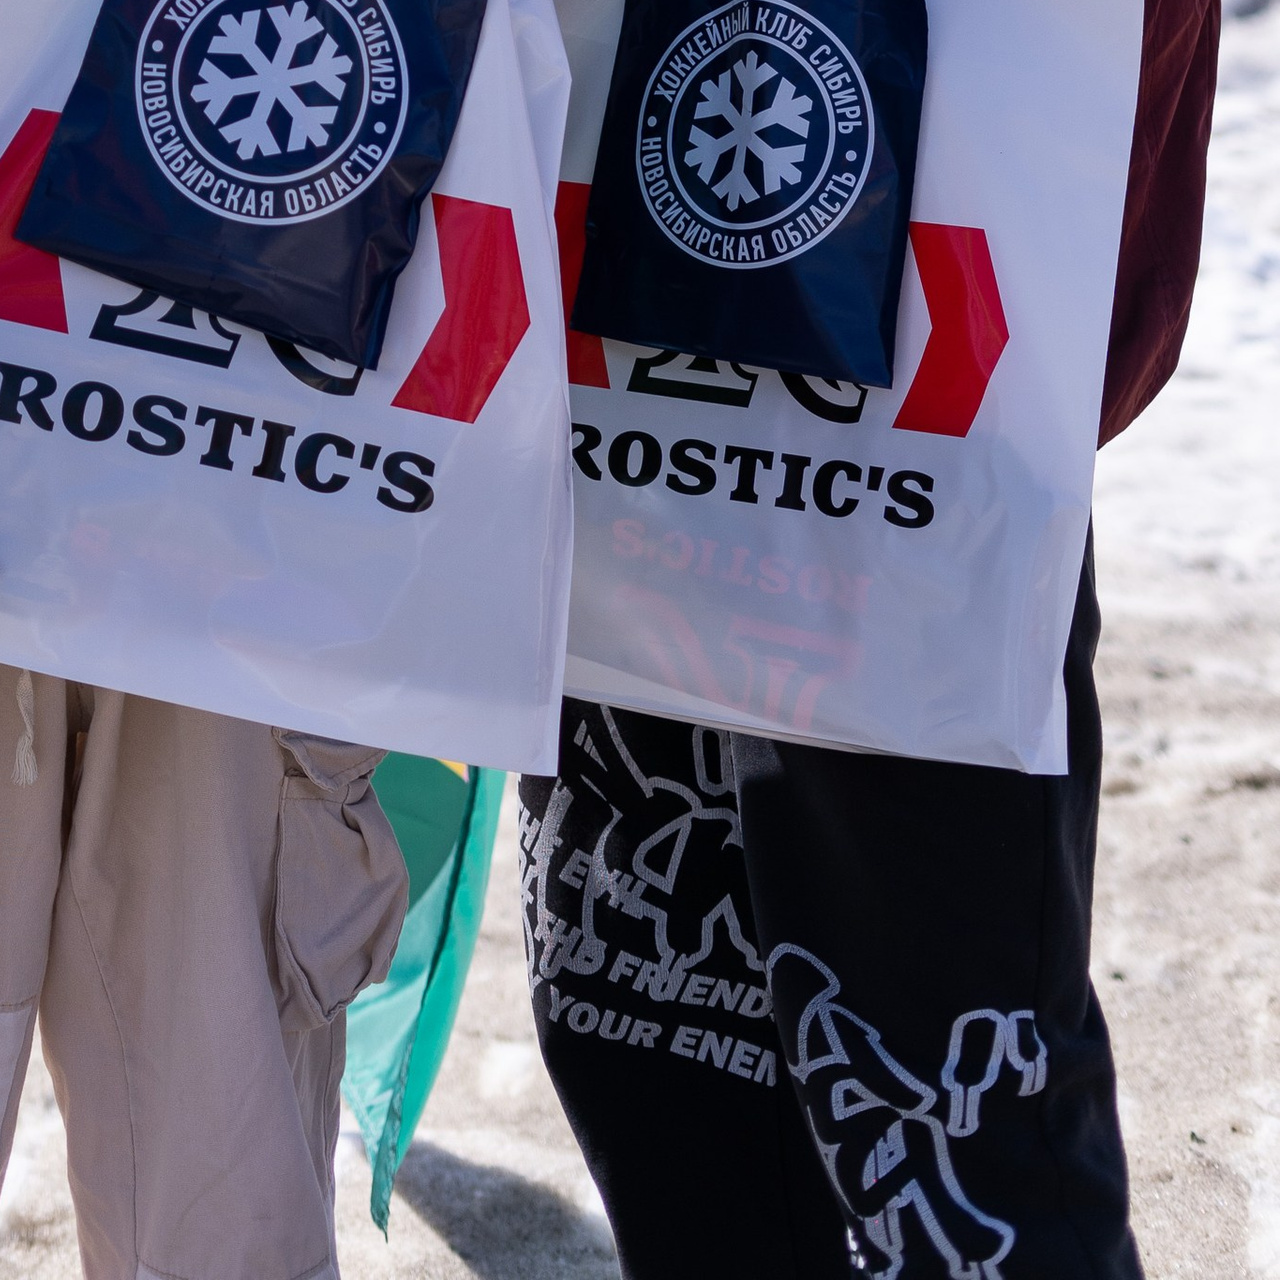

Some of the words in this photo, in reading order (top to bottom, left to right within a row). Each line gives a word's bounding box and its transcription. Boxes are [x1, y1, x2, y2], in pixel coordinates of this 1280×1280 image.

[356, 7, 396, 105] СИБИРЬ
[654, 2, 749, 103] ХОККЕЙНЫЙ
[755, 8, 814, 50] КЛУБ
[808, 45, 862, 134] СИБИРЬ
[143, 62, 274, 217] НОВОСИБИРСКАЯ
[285, 144, 383, 216] ОБЛАСТЬ
[642, 136, 766, 261] НОВОСИБИРСКАЯ
[770, 172, 857, 254] ОБЛАСТЬ
[548, 984, 662, 1048] YOUR
[608, 950, 775, 1022] FRIEND
